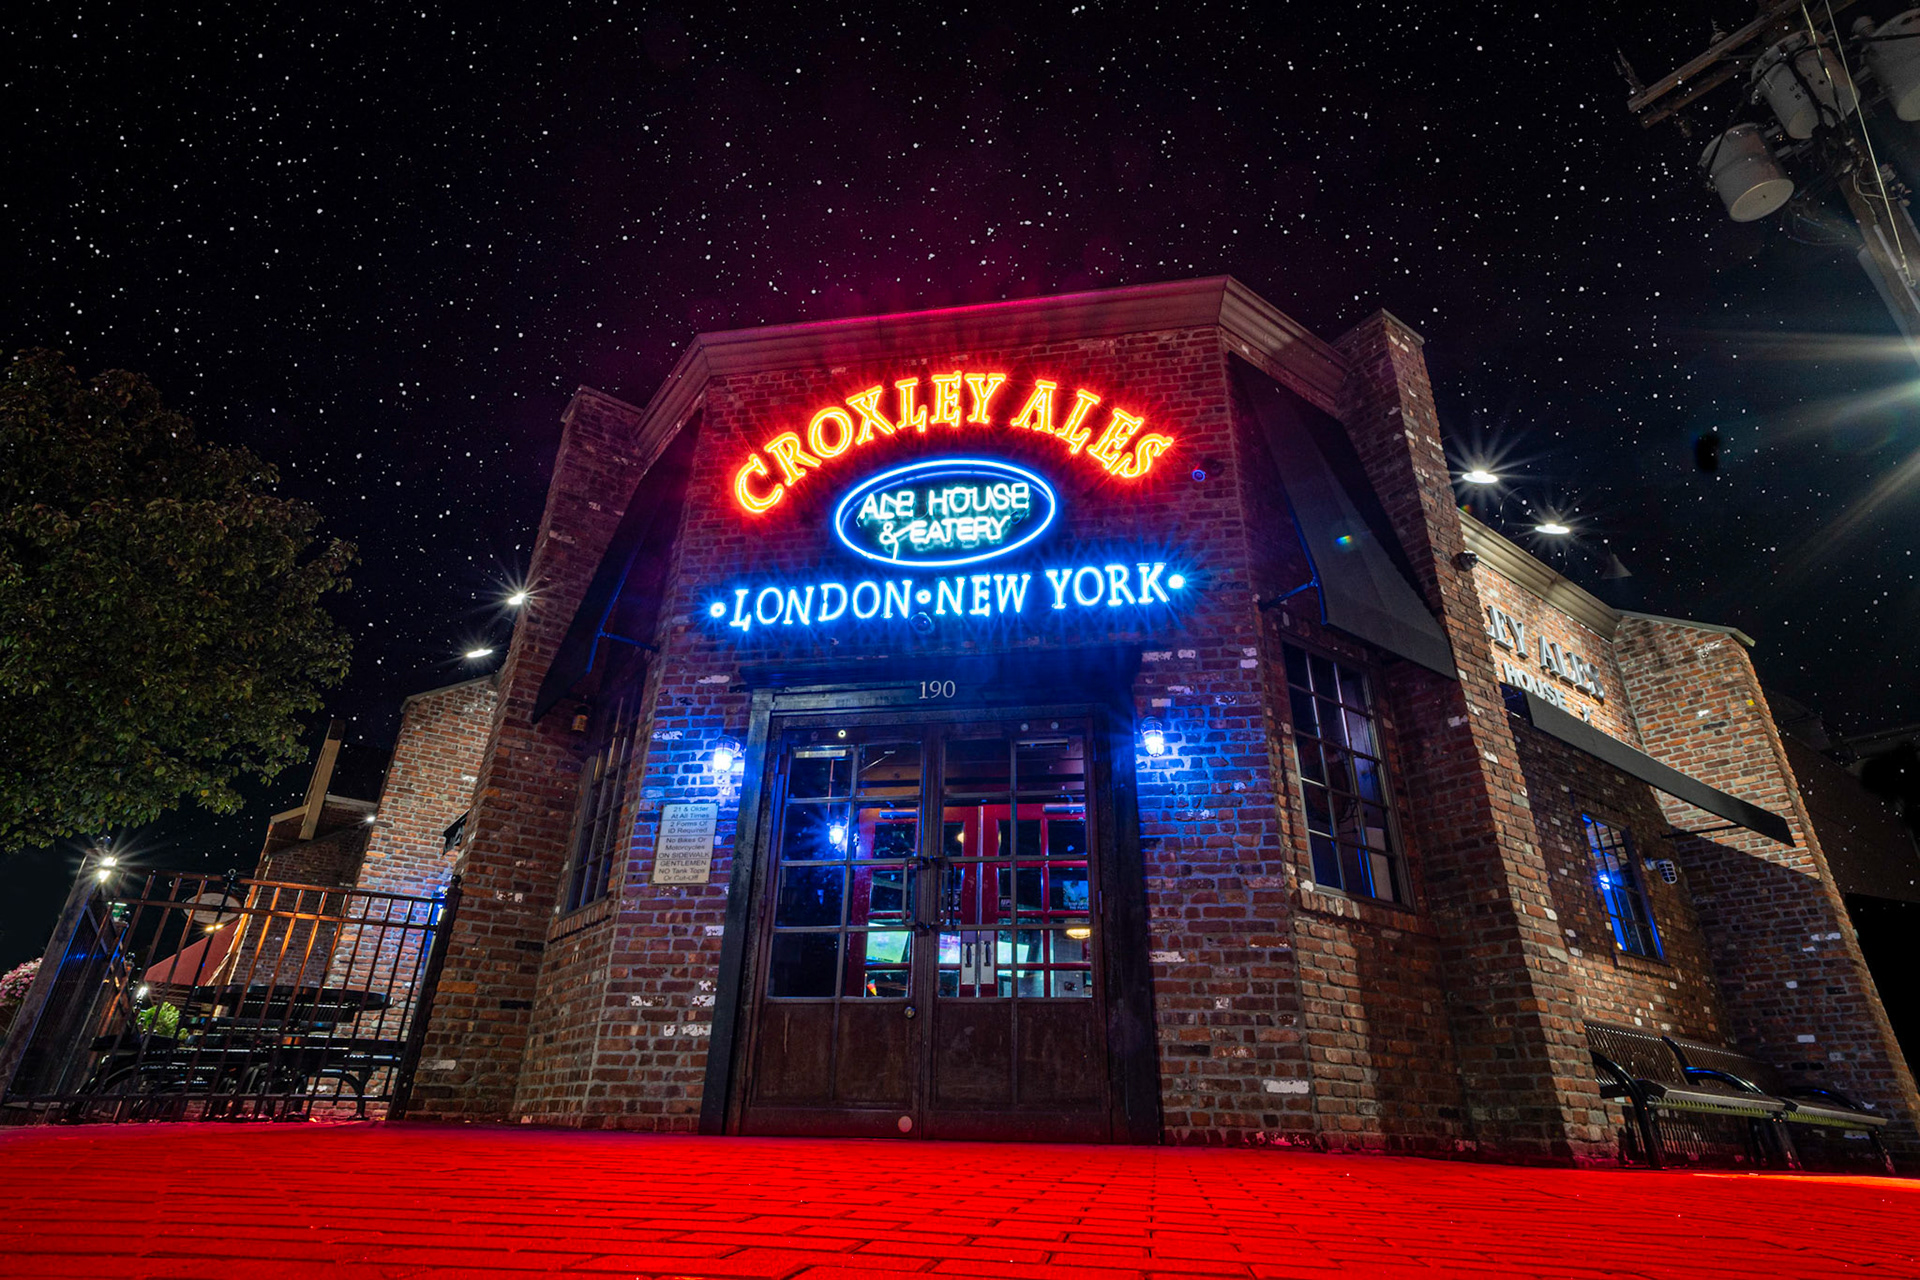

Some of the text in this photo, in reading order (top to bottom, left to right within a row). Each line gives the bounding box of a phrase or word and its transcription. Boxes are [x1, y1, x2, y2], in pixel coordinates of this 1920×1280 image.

[733, 370, 1175, 513] CROXLEY ALES
[861, 482, 1030, 520] ALE HOUSE
[879, 515, 1012, 546] & EATERY
[1046, 562, 1171, 610] YORK
[919, 680, 956, 699] 190
[1502, 660, 1572, 714] HOUSE
[1538, 634, 1605, 706] ALES
